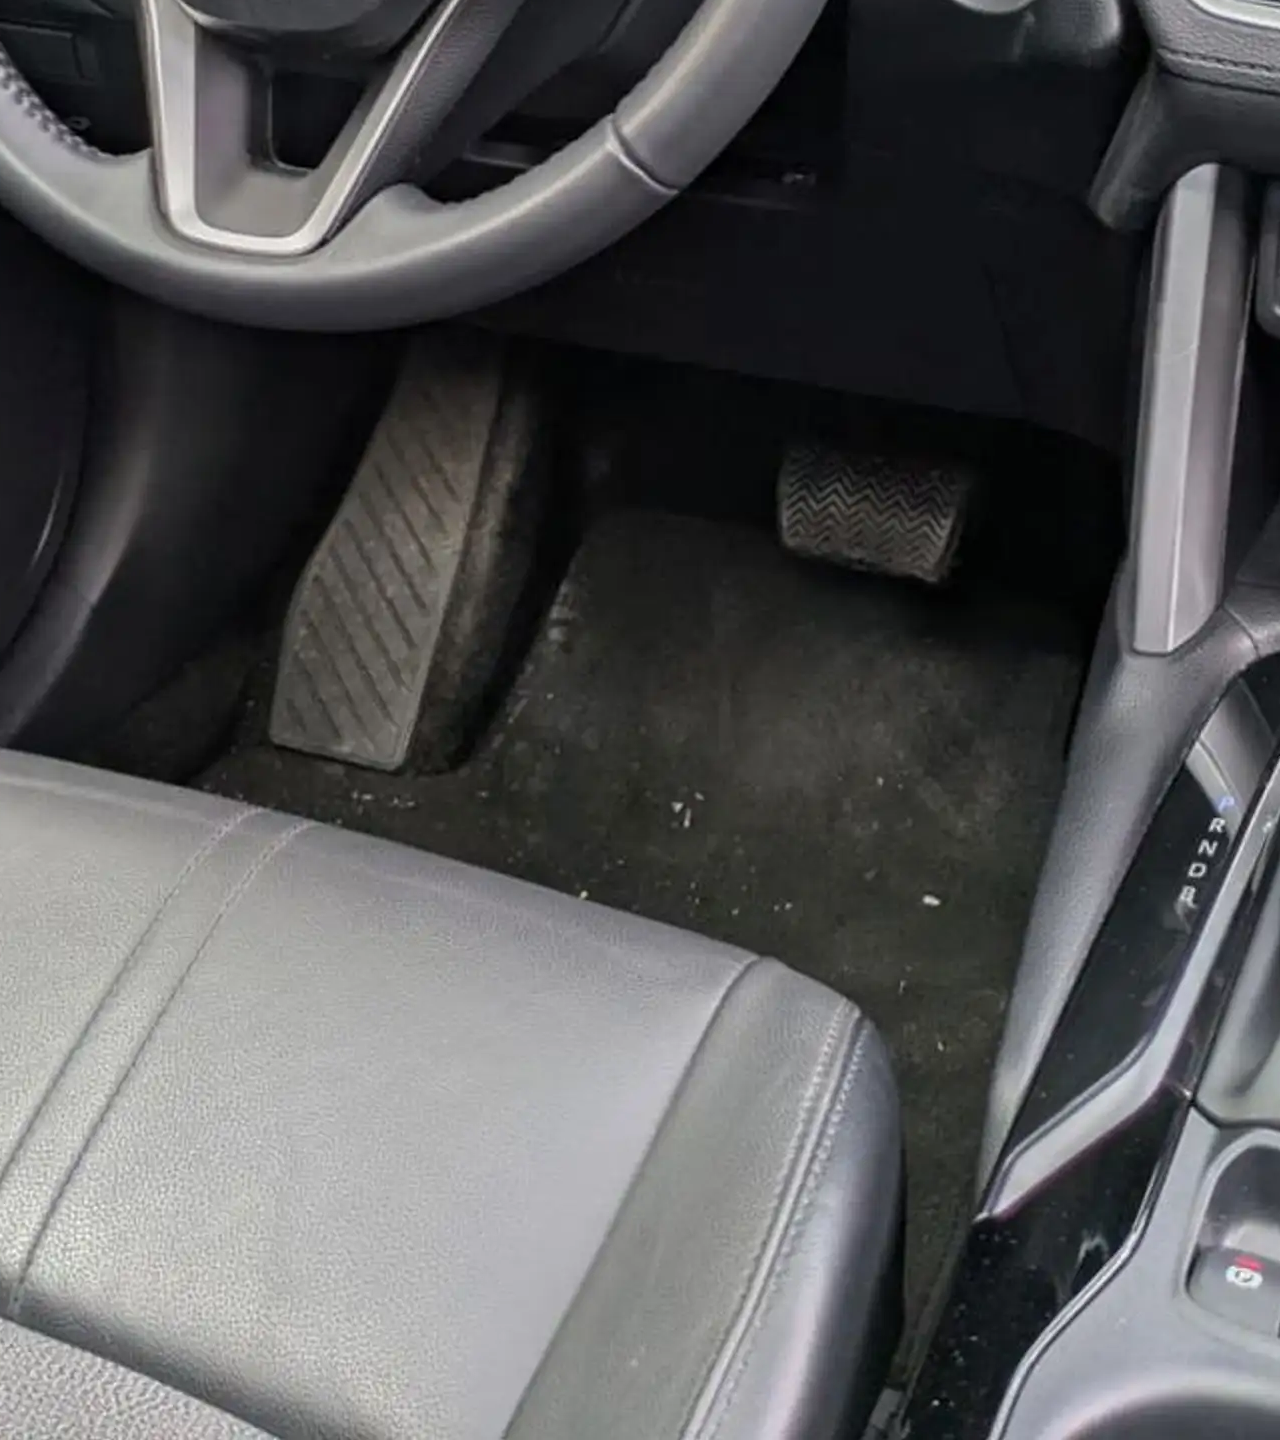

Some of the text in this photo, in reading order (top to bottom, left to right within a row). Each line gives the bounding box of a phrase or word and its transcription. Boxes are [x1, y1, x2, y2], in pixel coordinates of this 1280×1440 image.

[1208, 817, 1225, 833] R
[1198, 840, 1218, 857] N
[1188, 862, 1207, 878] D
